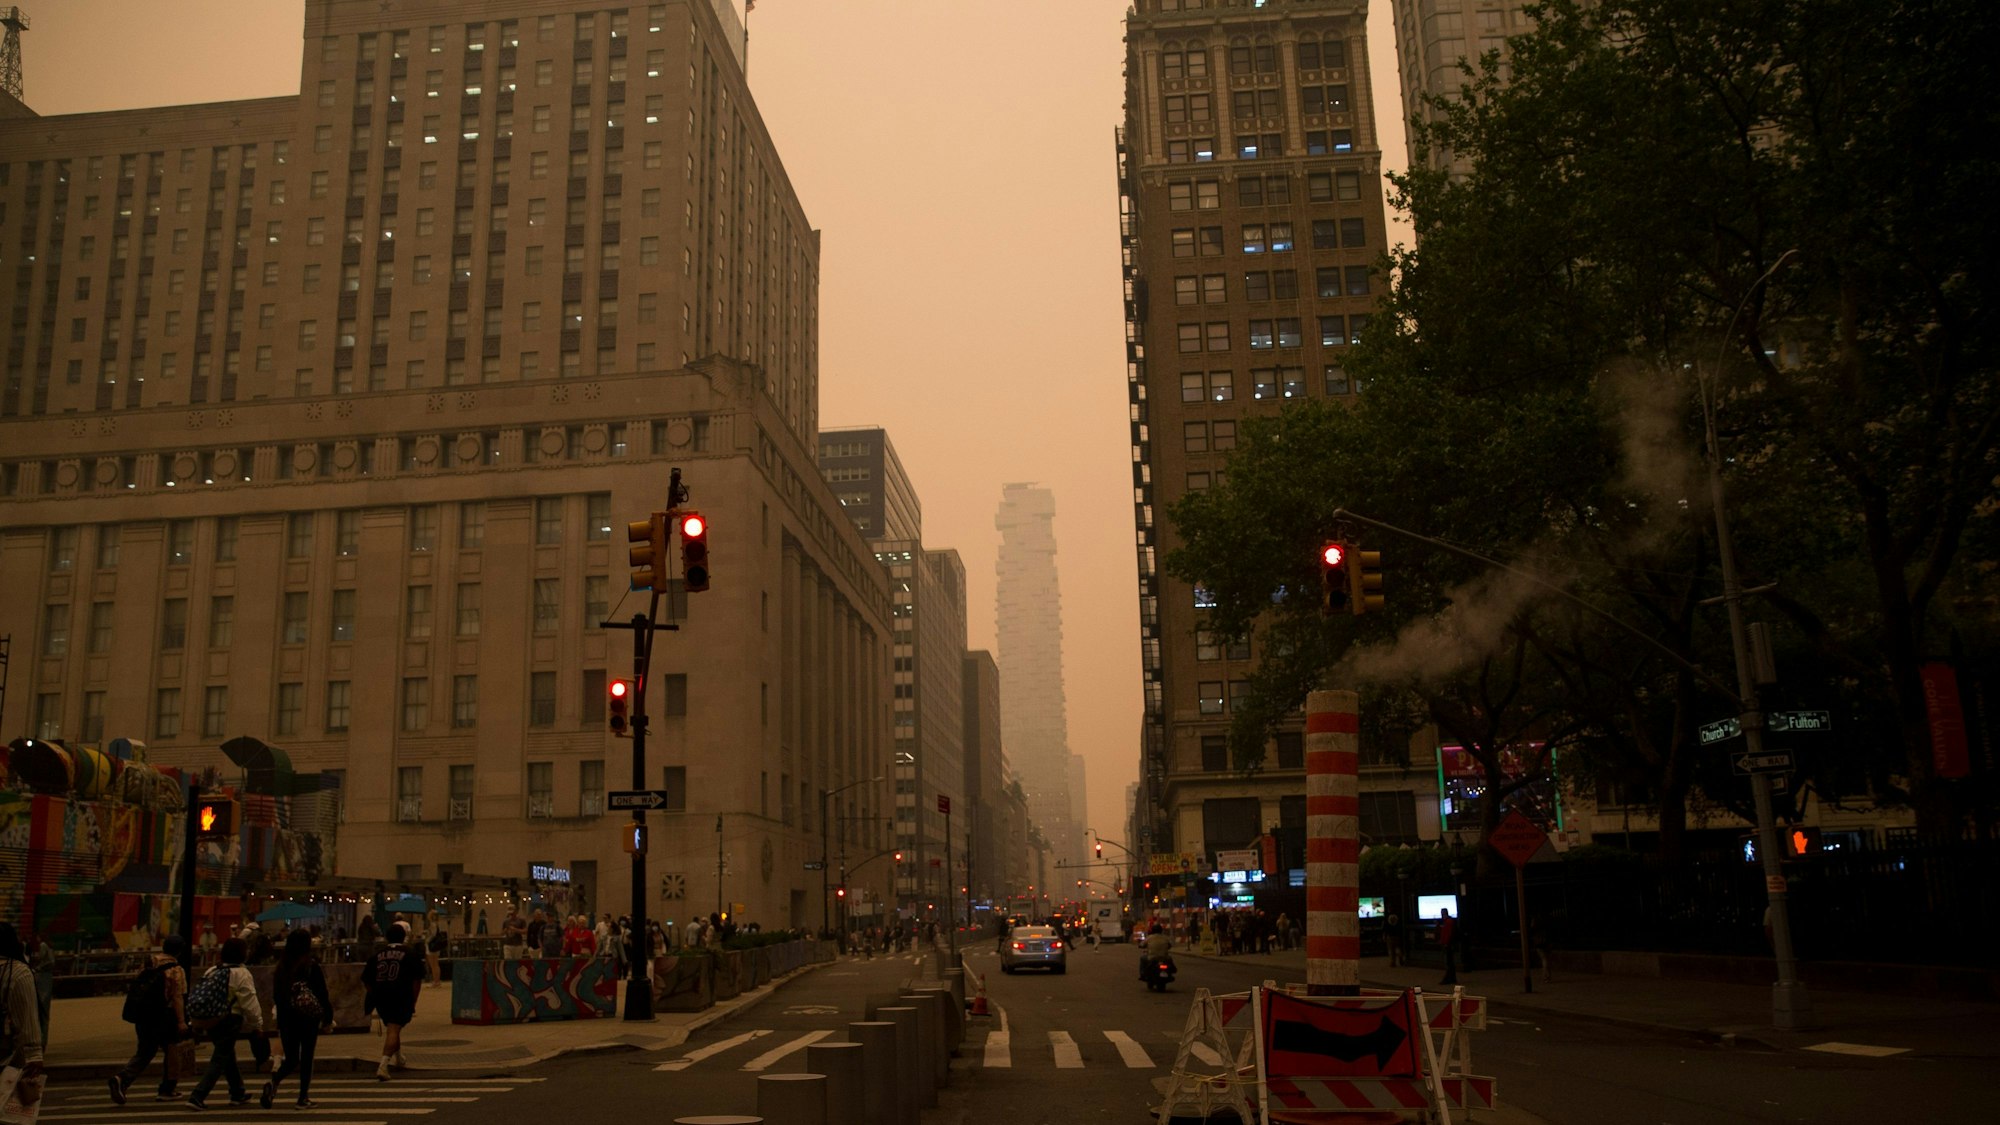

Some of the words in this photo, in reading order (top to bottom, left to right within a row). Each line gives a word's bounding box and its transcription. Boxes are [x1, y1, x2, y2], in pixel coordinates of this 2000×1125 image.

[1789, 716, 1820, 729] Fulton
[1702, 726, 1725, 743] Church
[1742, 759, 1761, 768] ONE
[1767, 757, 1785, 765] WAY
[616, 797, 634, 806] ONE
[533, 865, 547, 880] BEER
[548, 867, 570, 883] GARDEN
[1152, 863, 1173, 874] OPEN
[375, 960, 401, 982] 20
